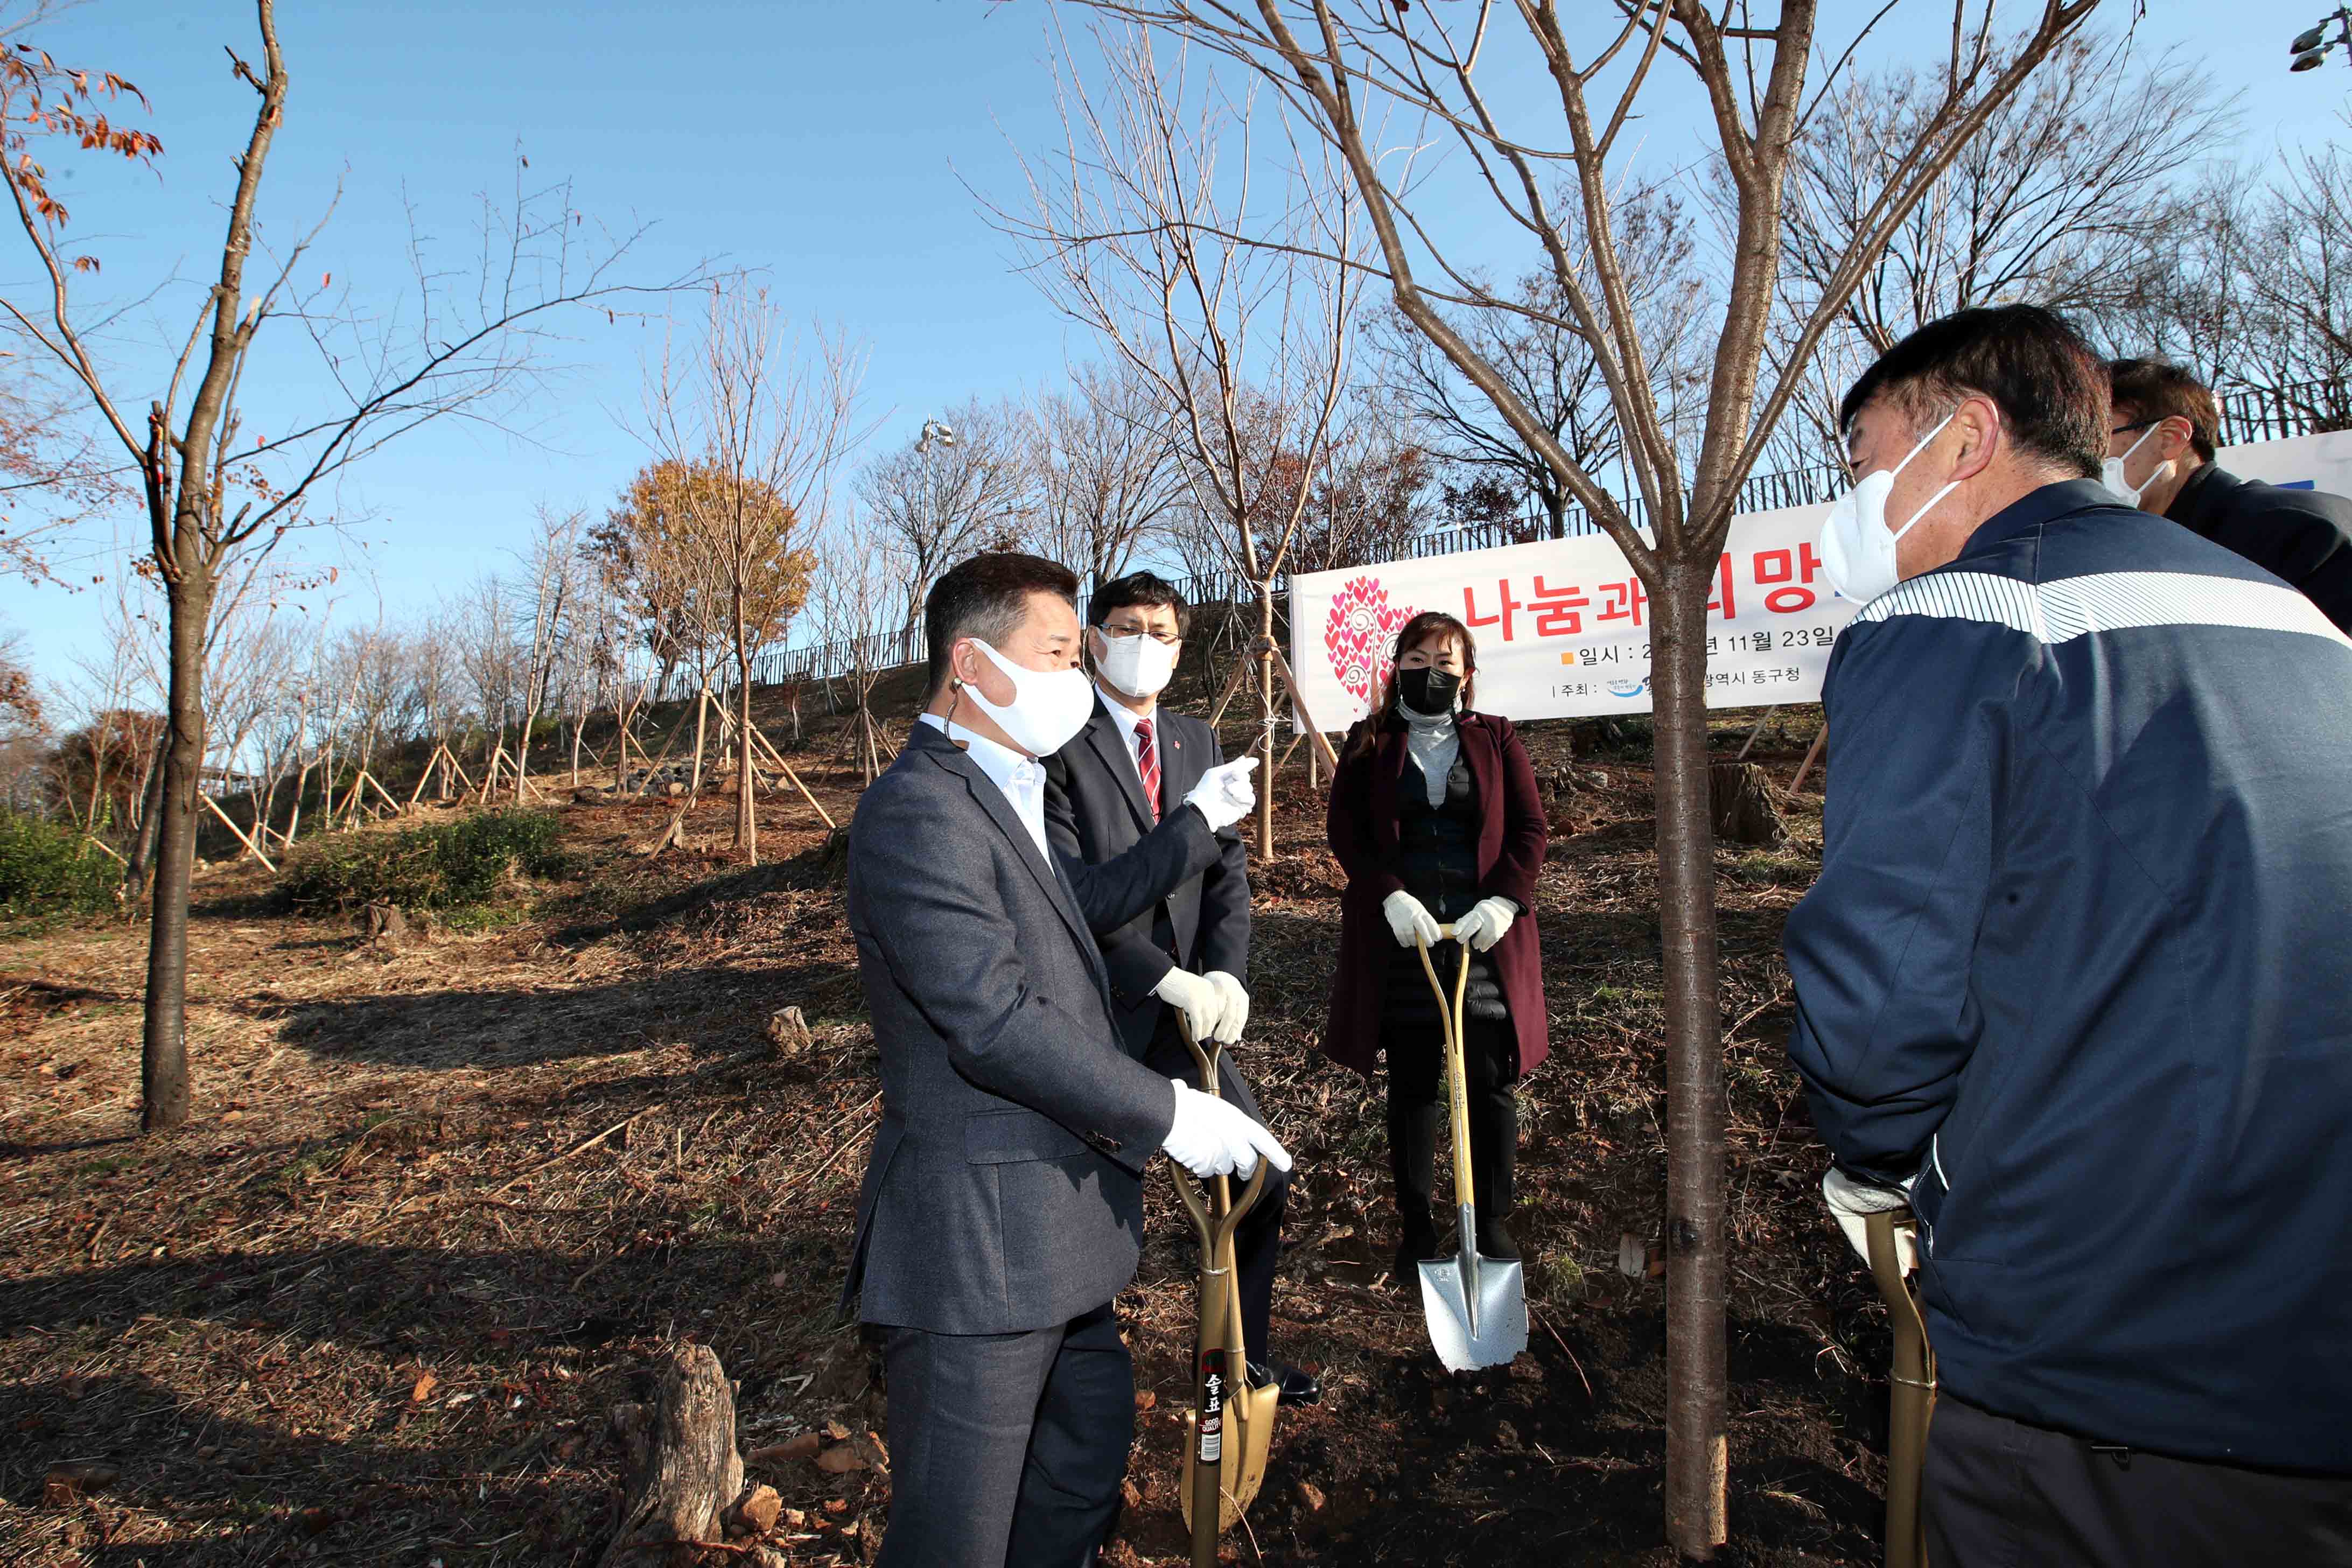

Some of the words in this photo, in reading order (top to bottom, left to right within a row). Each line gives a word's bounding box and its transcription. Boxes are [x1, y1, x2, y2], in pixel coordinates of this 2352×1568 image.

[1464, 576, 1647, 641] 나눔과
[1579, 645, 1619, 666] 일시
[1728, 631, 1772, 652] 11월
[1782, 626, 1833, 647] 23일
[1562, 683, 1588, 697] 주최
[1752, 667, 1800, 684] 동구청
[1202, 1420, 1221, 1432] QUALITY
[1205, 1417, 1219, 1426] GOOD
